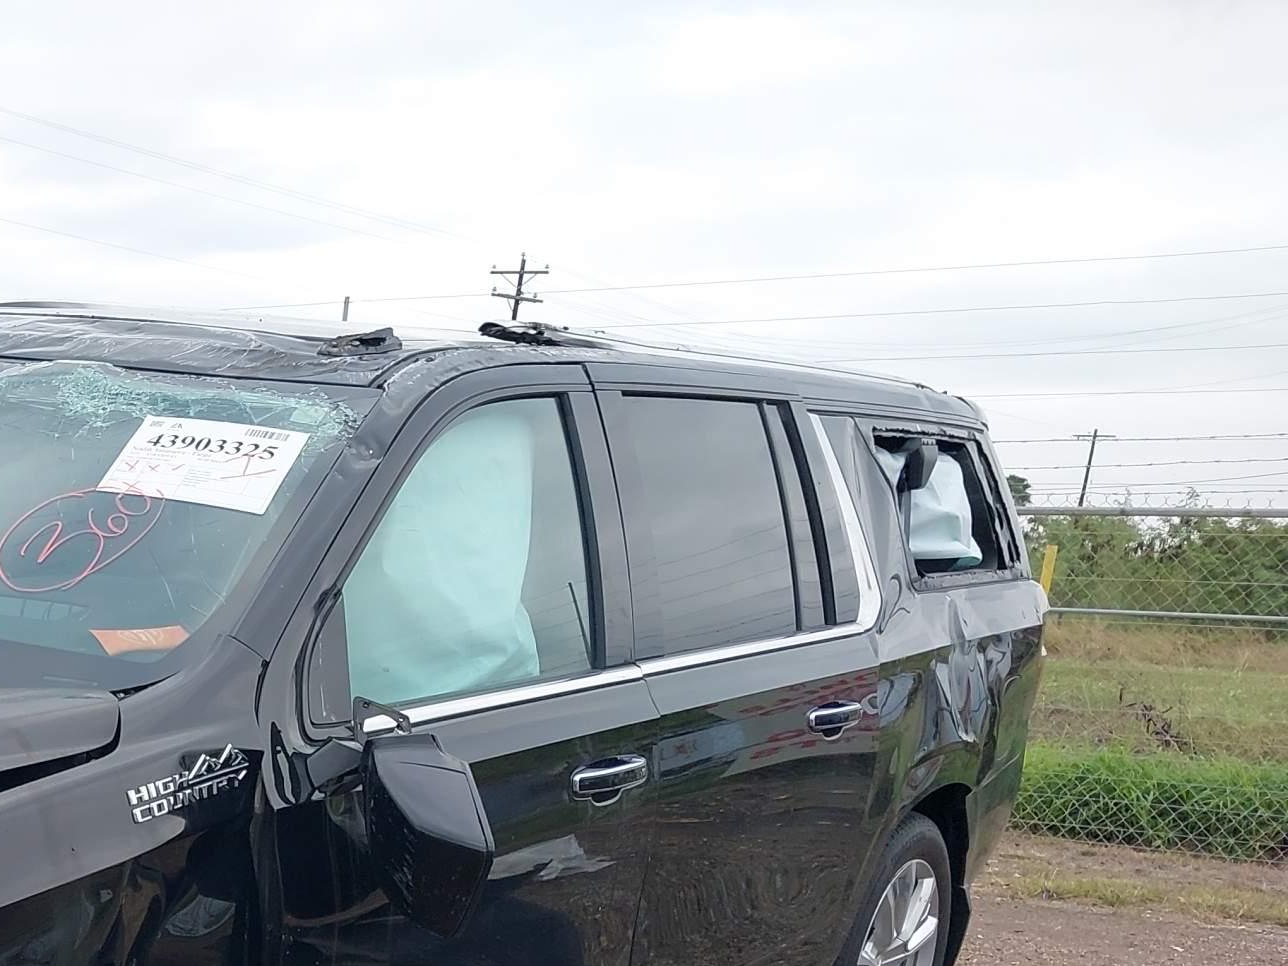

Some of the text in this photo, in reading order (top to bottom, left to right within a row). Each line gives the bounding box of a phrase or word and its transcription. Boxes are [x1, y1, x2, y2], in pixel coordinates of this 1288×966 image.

[147, 433, 280, 460] 43903325
[127, 771, 190, 806] HIGH
[131, 769, 248, 824] COUNTRY
